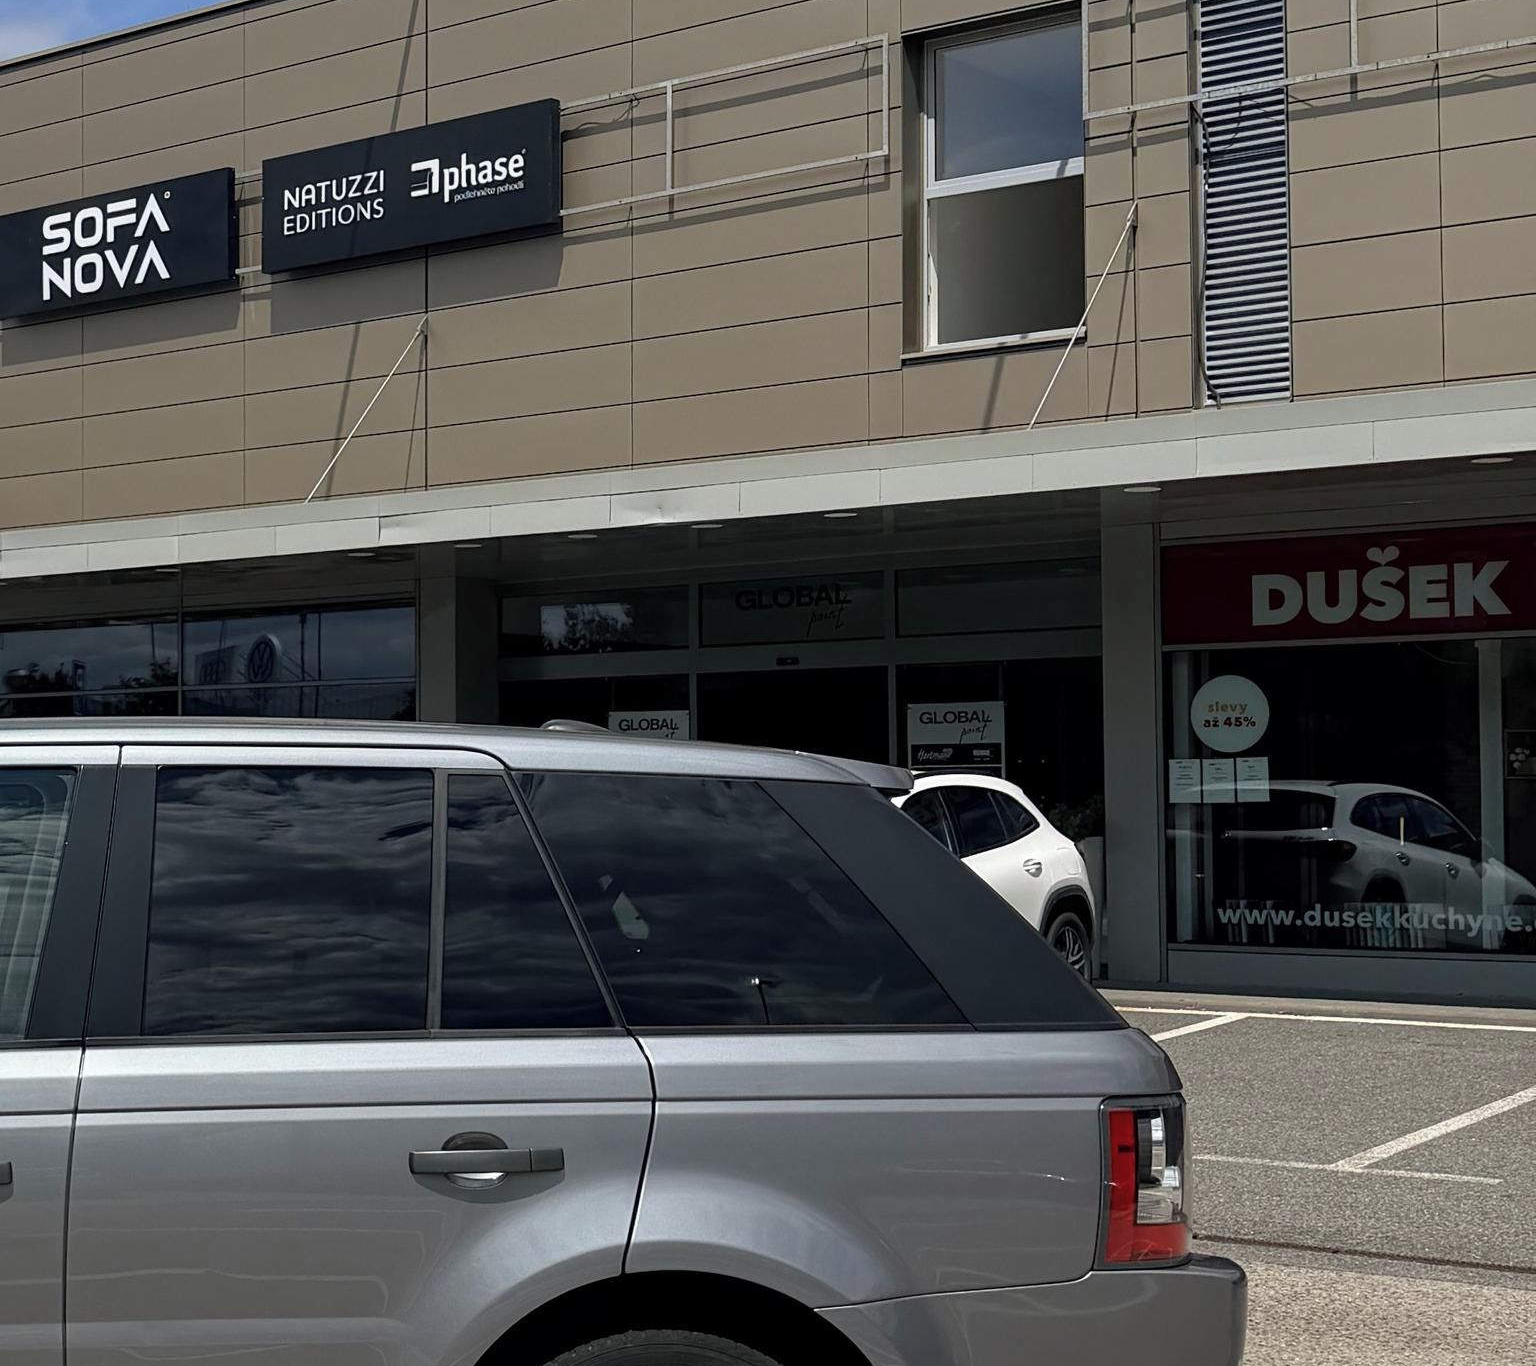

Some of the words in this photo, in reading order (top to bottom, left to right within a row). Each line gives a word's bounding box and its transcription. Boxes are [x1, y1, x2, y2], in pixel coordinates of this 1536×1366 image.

[284, 170, 384, 210] NATUZZI
[443, 152, 525, 203] phase
[42, 192, 171, 255] SOFA
[284, 198, 384, 235] EDITIONS
[42, 239, 171, 301] NOVA
[735, 584, 852, 611] GLOBAL
[1251, 545, 1513, 626] DUŠEK
[618, 718, 679, 732] GLOBAL
[919, 710, 993, 724] GLOBAL
[1207, 701, 1249, 715] slevy
[1223, 716, 1257, 727] 45%
[1216, 903, 1536, 938] www.dusekkuchyne.
